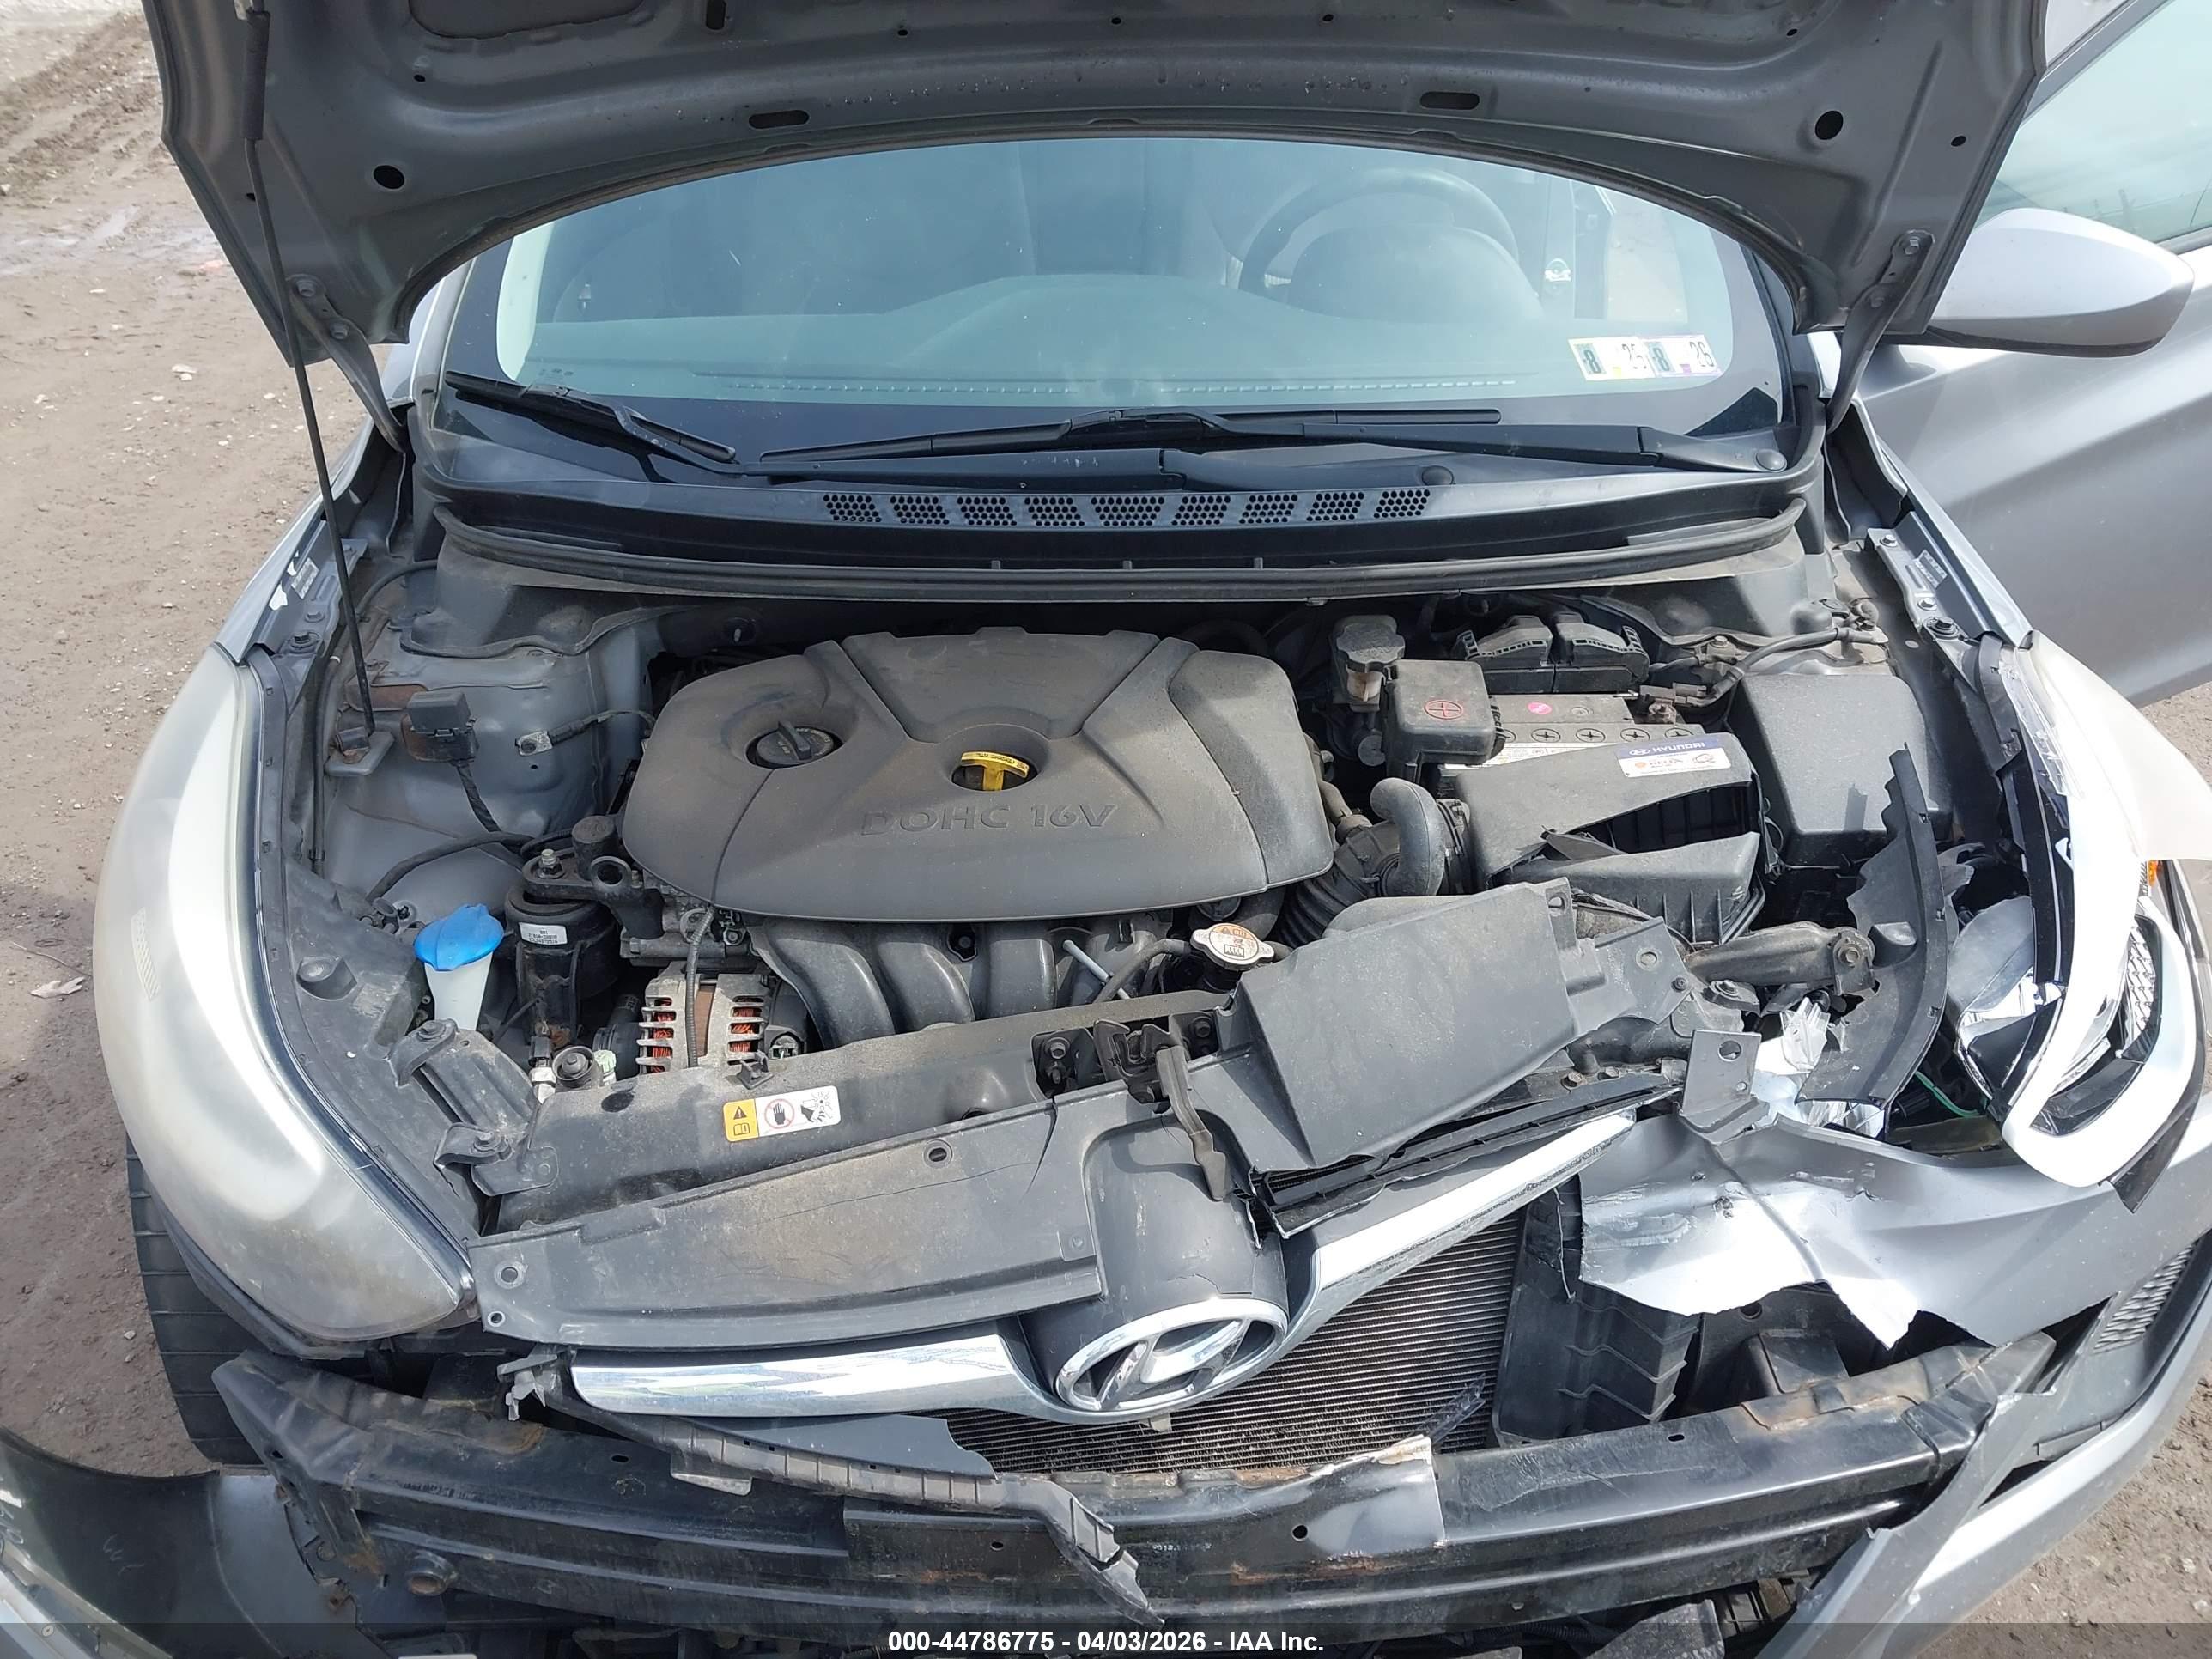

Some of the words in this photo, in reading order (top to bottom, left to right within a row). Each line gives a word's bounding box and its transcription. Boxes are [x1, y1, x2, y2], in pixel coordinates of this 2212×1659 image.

[1621, 343, 1647, 369] 25
[1689, 341, 1714, 368] 26
[1652, 741, 1706, 753] HYUNDAI
[860, 805, 1010, 836] DOHC
[1030, 804, 1117, 829] 16V
